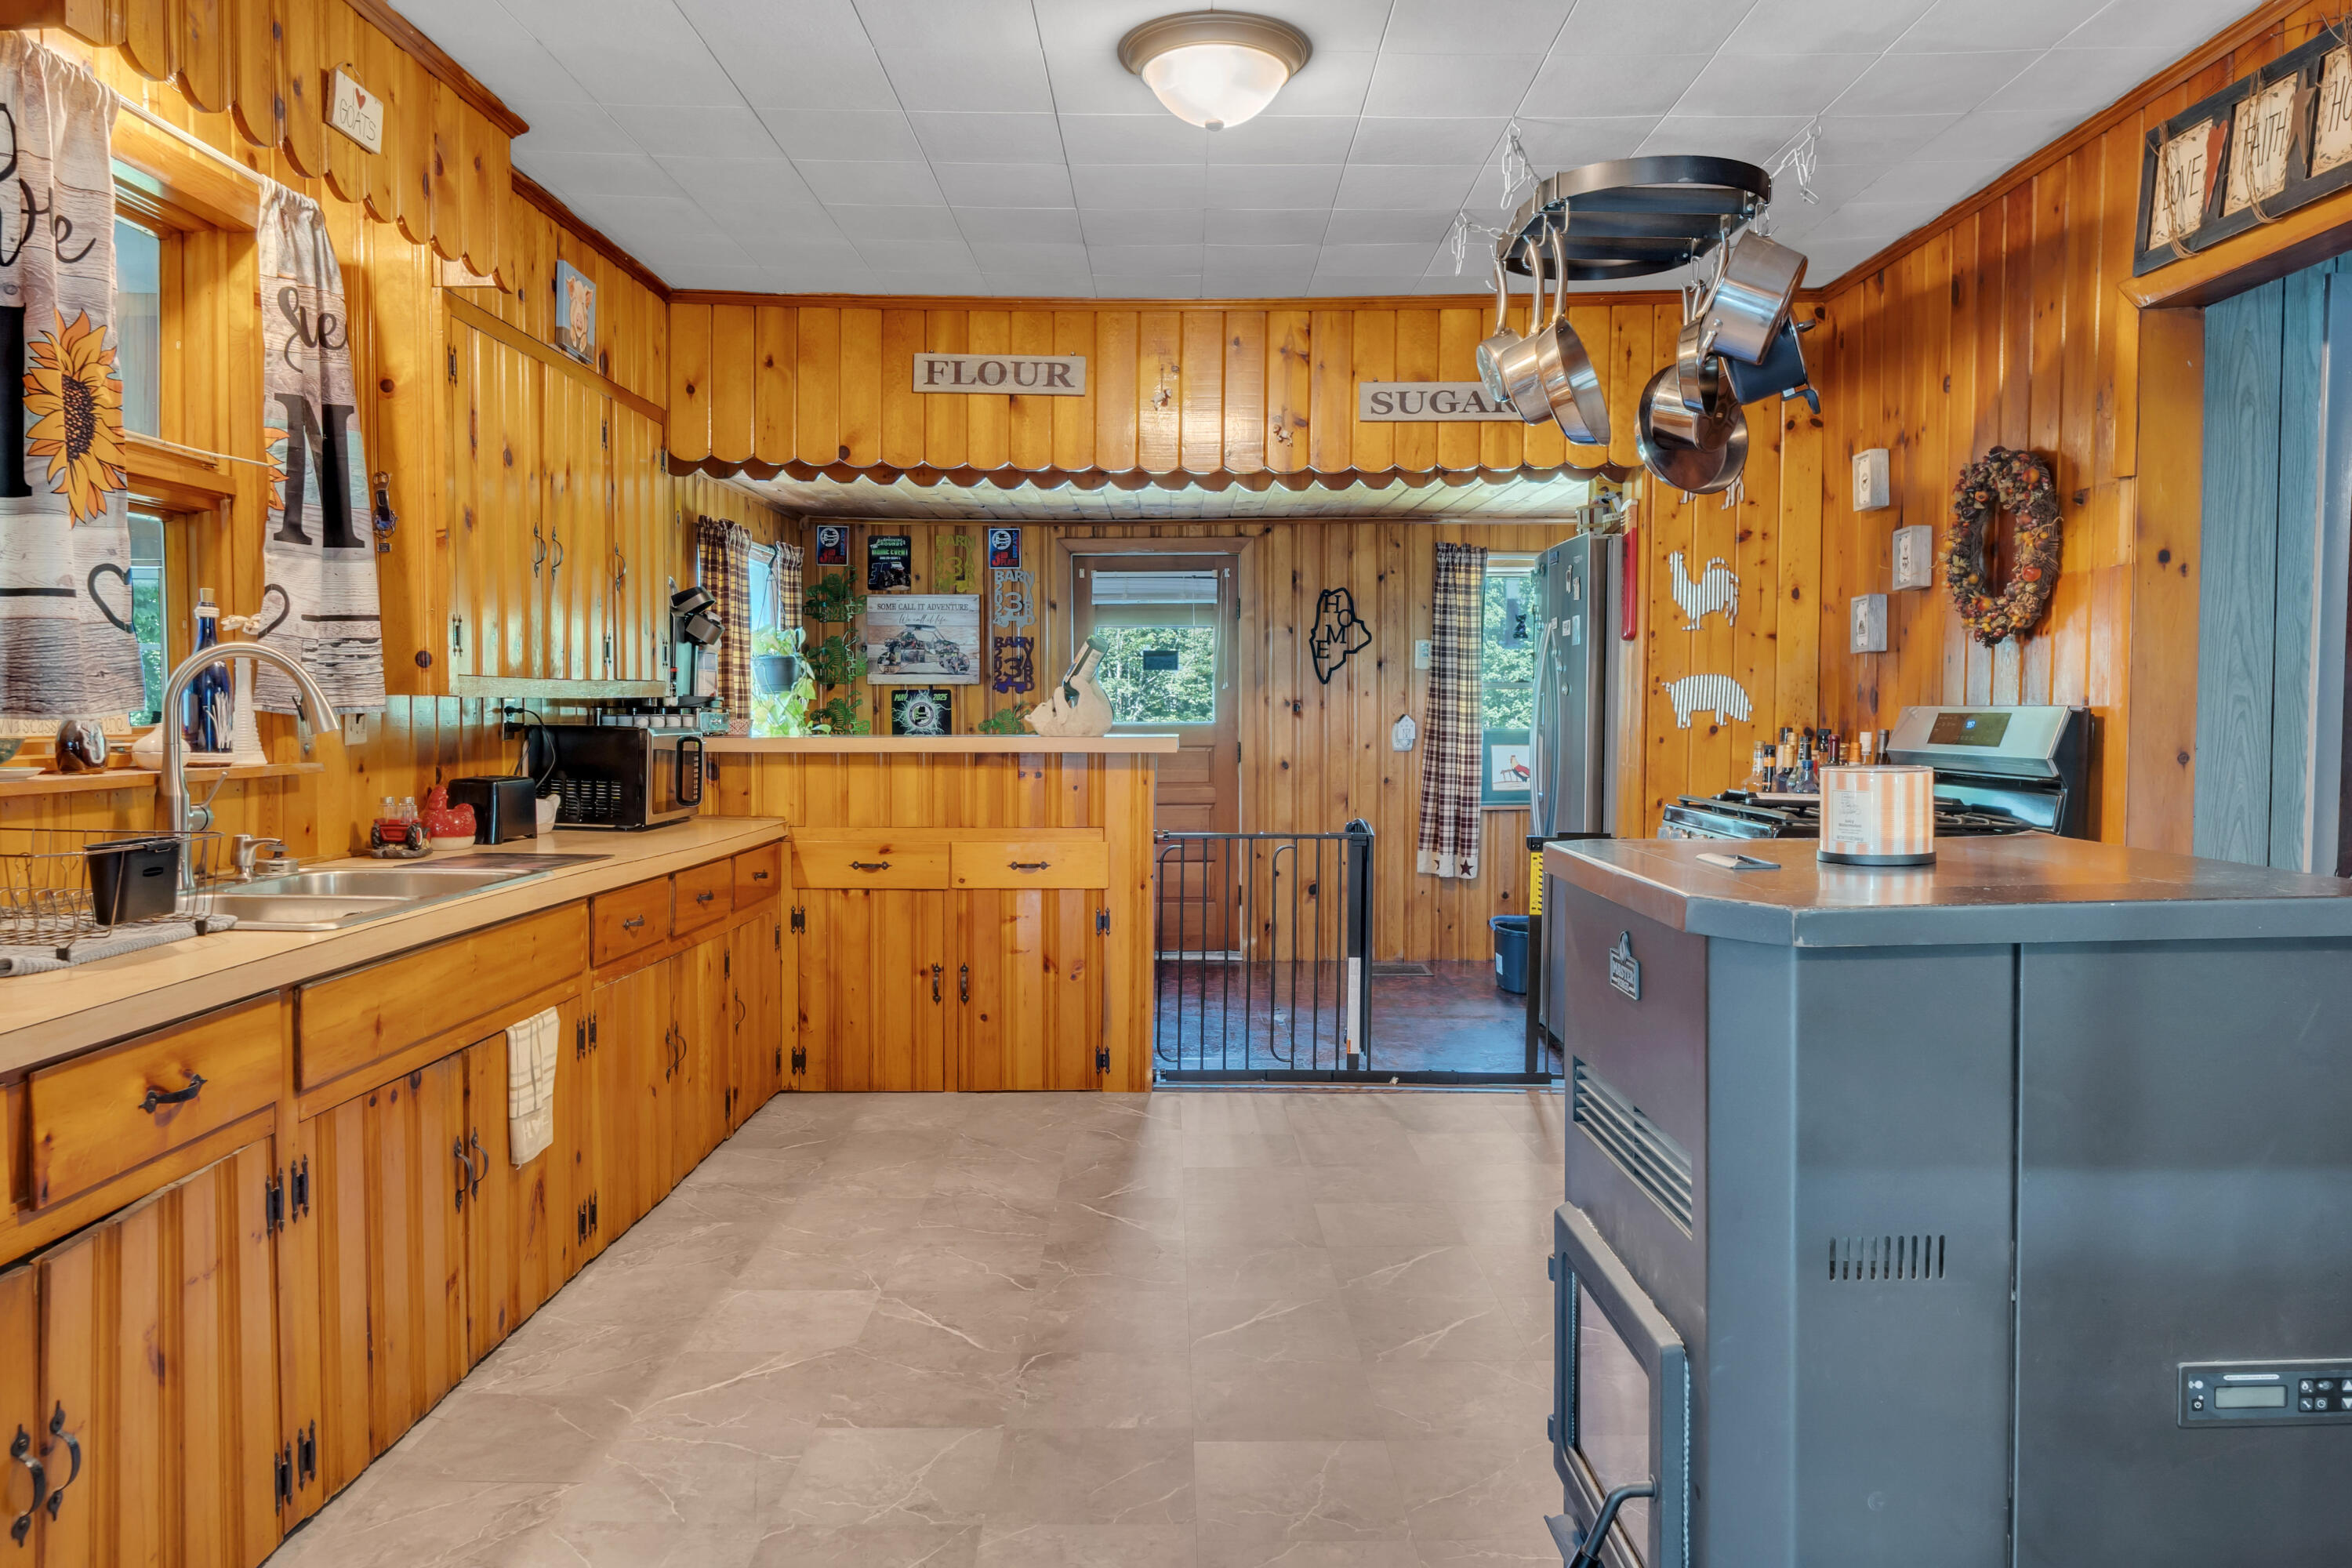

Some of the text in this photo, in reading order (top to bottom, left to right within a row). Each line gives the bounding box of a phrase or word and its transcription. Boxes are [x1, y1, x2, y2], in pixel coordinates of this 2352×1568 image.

[339, 99, 376, 141] GOATS
[2241, 107, 2288, 176] FAITH
[2163, 154, 2203, 211] LOVE
[924, 360, 1076, 388] FLOUR
[994, 570, 1035, 583] BARN
[1004, 592, 1023, 613] 3
[994, 637, 1034, 648] BARN
[1004, 657, 1023, 678] 3
[1612, 960, 1635, 985] MASTER
